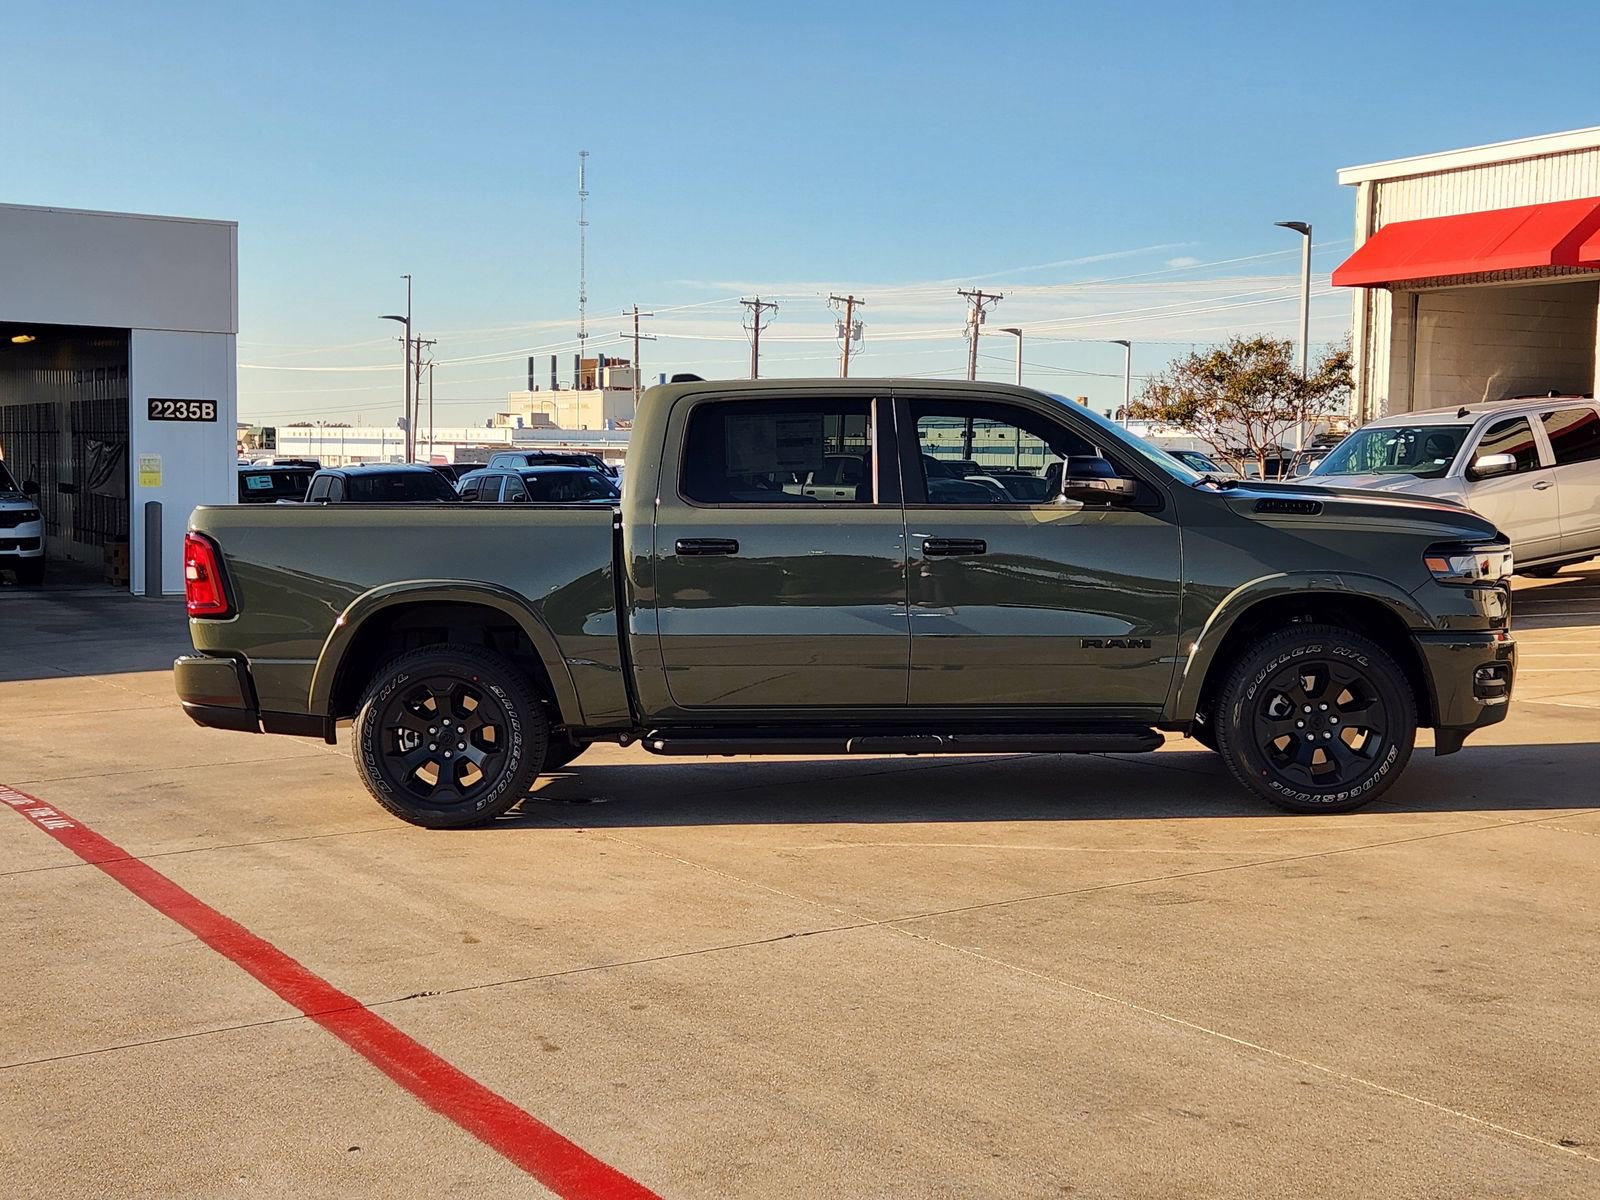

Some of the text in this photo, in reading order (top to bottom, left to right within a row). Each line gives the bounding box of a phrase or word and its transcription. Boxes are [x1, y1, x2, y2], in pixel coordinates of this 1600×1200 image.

[151, 401, 215, 419] 2235B
[1080, 639, 1152, 649] RAM
[1246, 644, 1323, 700] DUELER
[362, 706, 393, 793] DUELER
[476, 685, 523, 811] BRIDGESTONE
[1268, 744, 1399, 804] BRIDGESTONE
